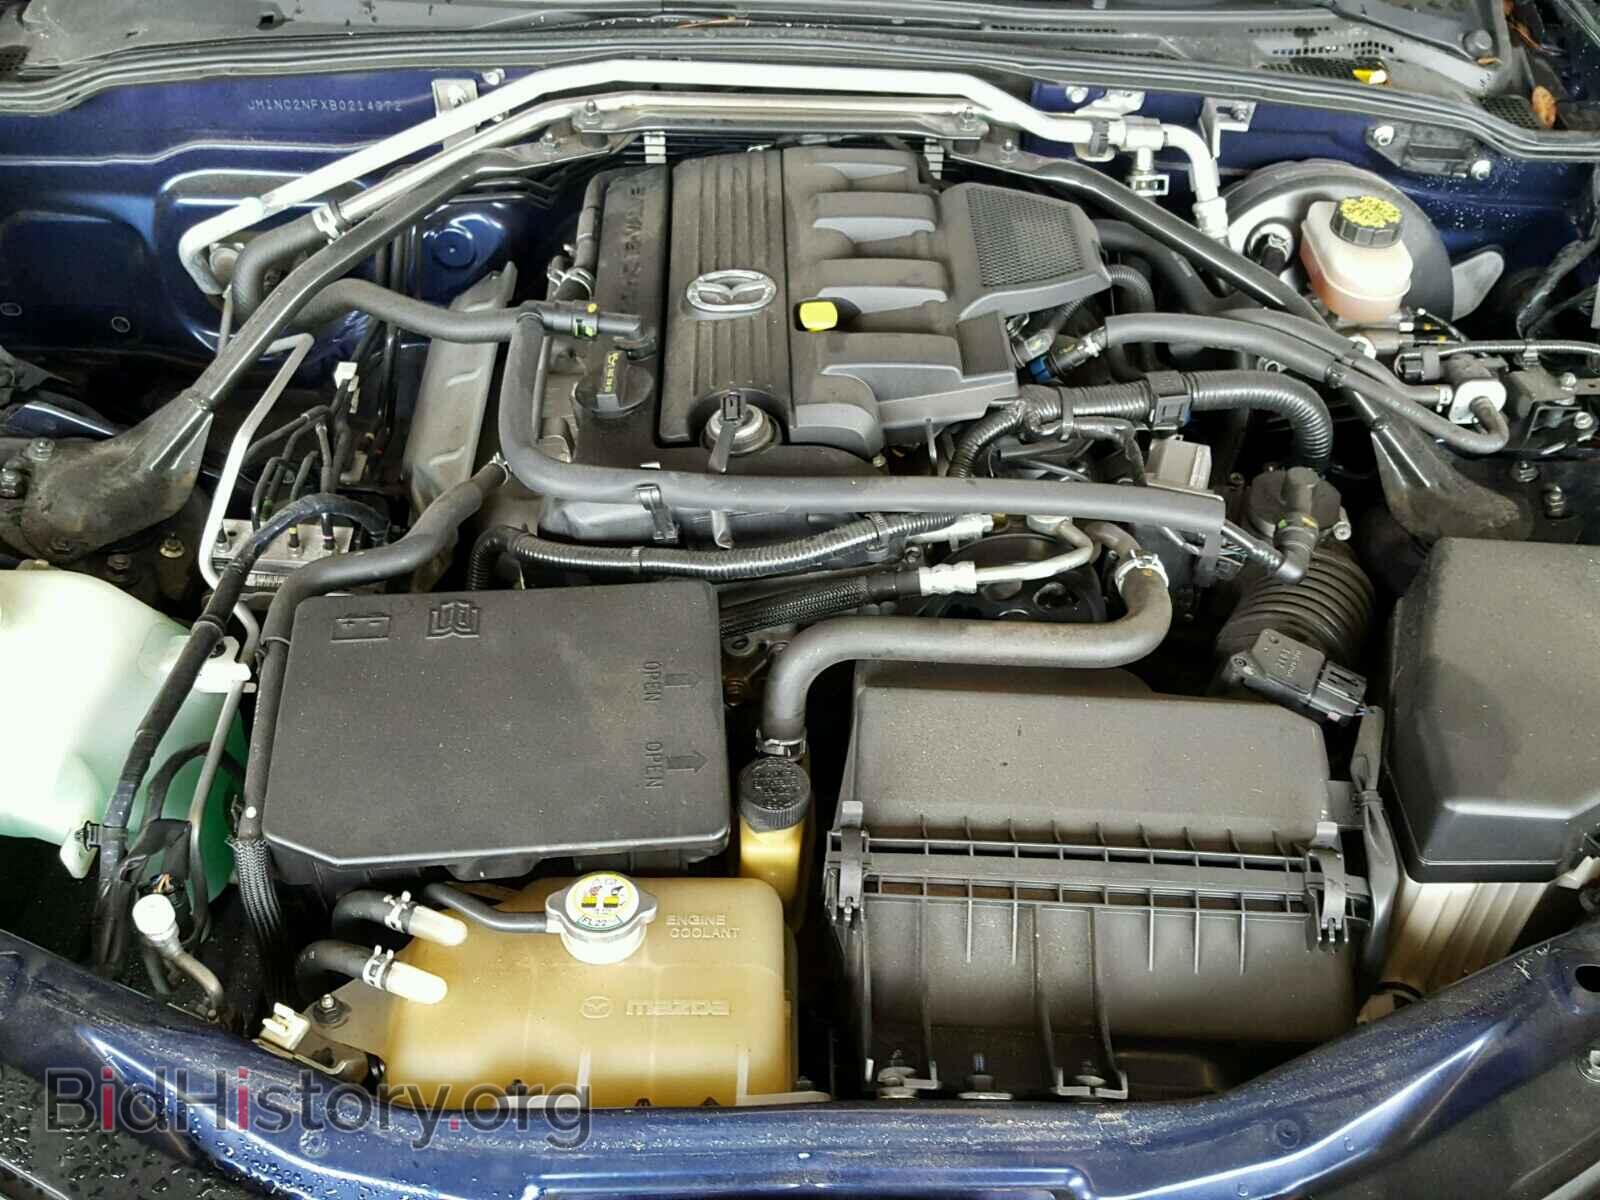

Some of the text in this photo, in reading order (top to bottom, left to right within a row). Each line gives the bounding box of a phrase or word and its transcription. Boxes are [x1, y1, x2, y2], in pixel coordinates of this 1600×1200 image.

[643, 661, 663, 704] OPEN
[646, 741, 664, 790] OPEN
[665, 914, 727, 926] ENGINE
[670, 927, 741, 939] COOLANT
[626, 999, 730, 1016] mazda
